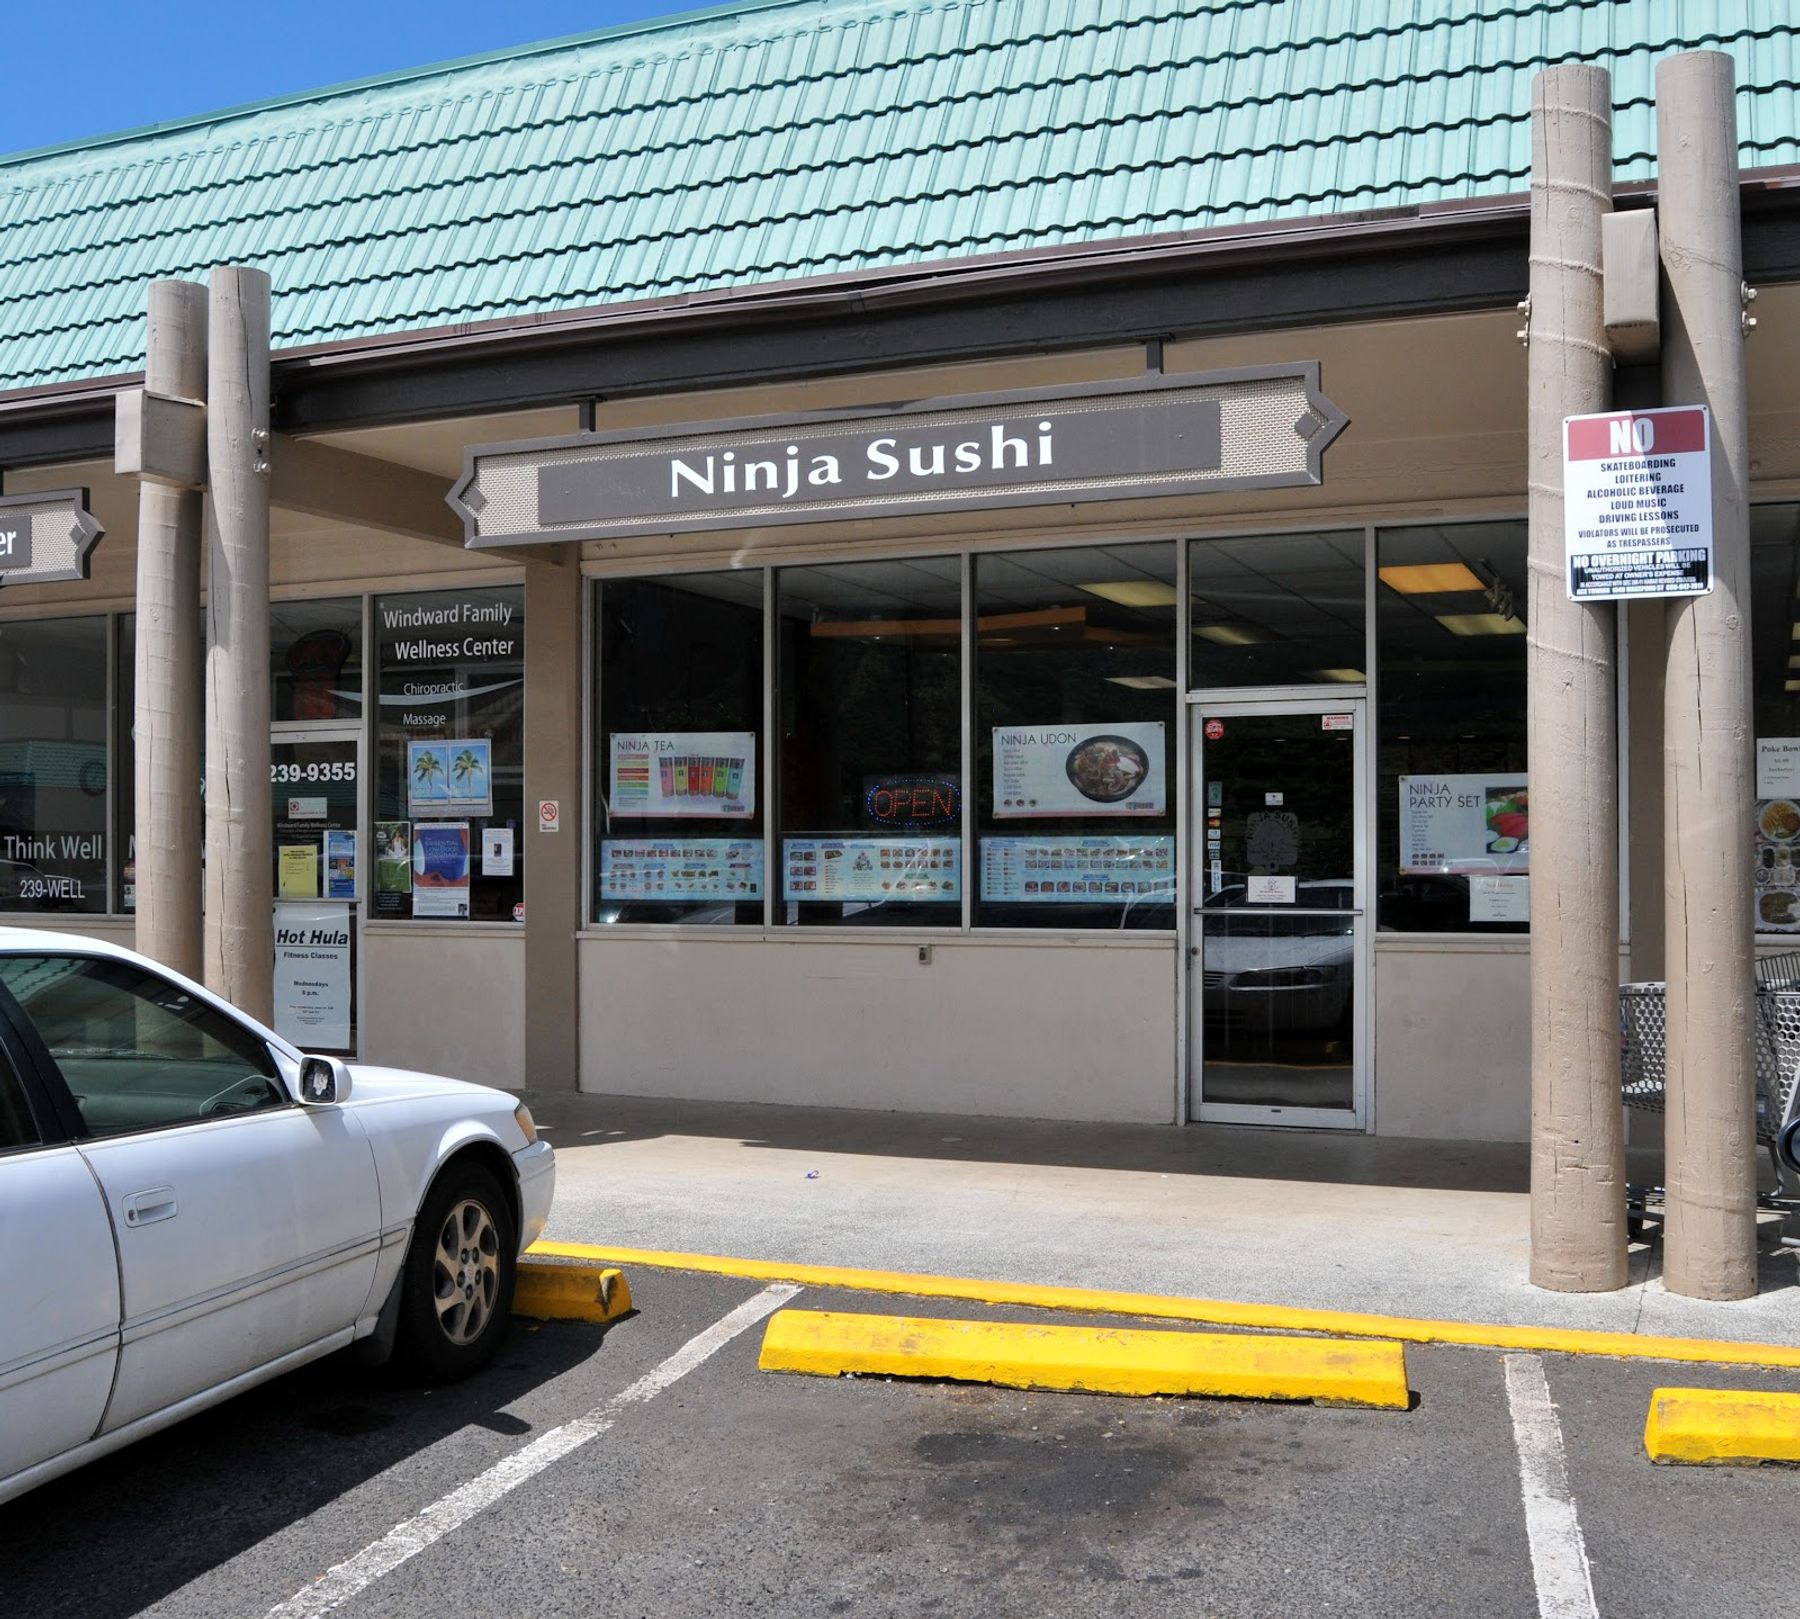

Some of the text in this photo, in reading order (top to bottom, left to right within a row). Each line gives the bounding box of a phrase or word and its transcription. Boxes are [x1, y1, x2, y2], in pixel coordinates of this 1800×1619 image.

[1610, 417, 1655, 454] NO
[671, 421, 1053, 498] Ninja Sushi
[1600, 458, 1676, 472] SKATEBOARDING
[1615, 472, 1662, 484] LOITERING
[1587, 484, 1685, 499] ALCOHOLIC BEVERAGE
[1611, 498, 1667, 510] LOUD MUSIC
[1599, 510, 1679, 524] DRIVING LESSONS
[1578, 524, 1699, 538] VIOLATORS WILL BE PROSECUTED
[1607, 536, 1671, 548] AS TRESPASSERS
[1573, 549, 1706, 568] NO OVERNIGHT PARKING
[1584, 565, 1633, 573] UNAUTHORIZED
[1634, 563, 1665, 571] VEHICLES
[384, 602, 513, 629] Windward Family
[395, 637, 514, 660] Wellness Center
[403, 681, 465, 696] Chiropractic
[403, 713, 447, 727] Massage
[617, 740, 675, 751] NINJA TEA
[1001, 732, 1076, 746] NINJA UDON
[1761, 745, 1780, 753] Poke
[270, 762, 356, 782] 239-9355
[1409, 783, 1451, 795] NINJA
[874, 788, 952, 817] OPEN
[1409, 795, 1481, 808] PARTY SET
[4, 834, 55, 860] Think
[60, 834, 103, 860] Well
[20, 879, 86, 899] 239-WELL
[276, 929, 348, 945] Hot Hula
[310, 952, 339, 960] Classes
[293, 980, 329, 988] Wednesdays
